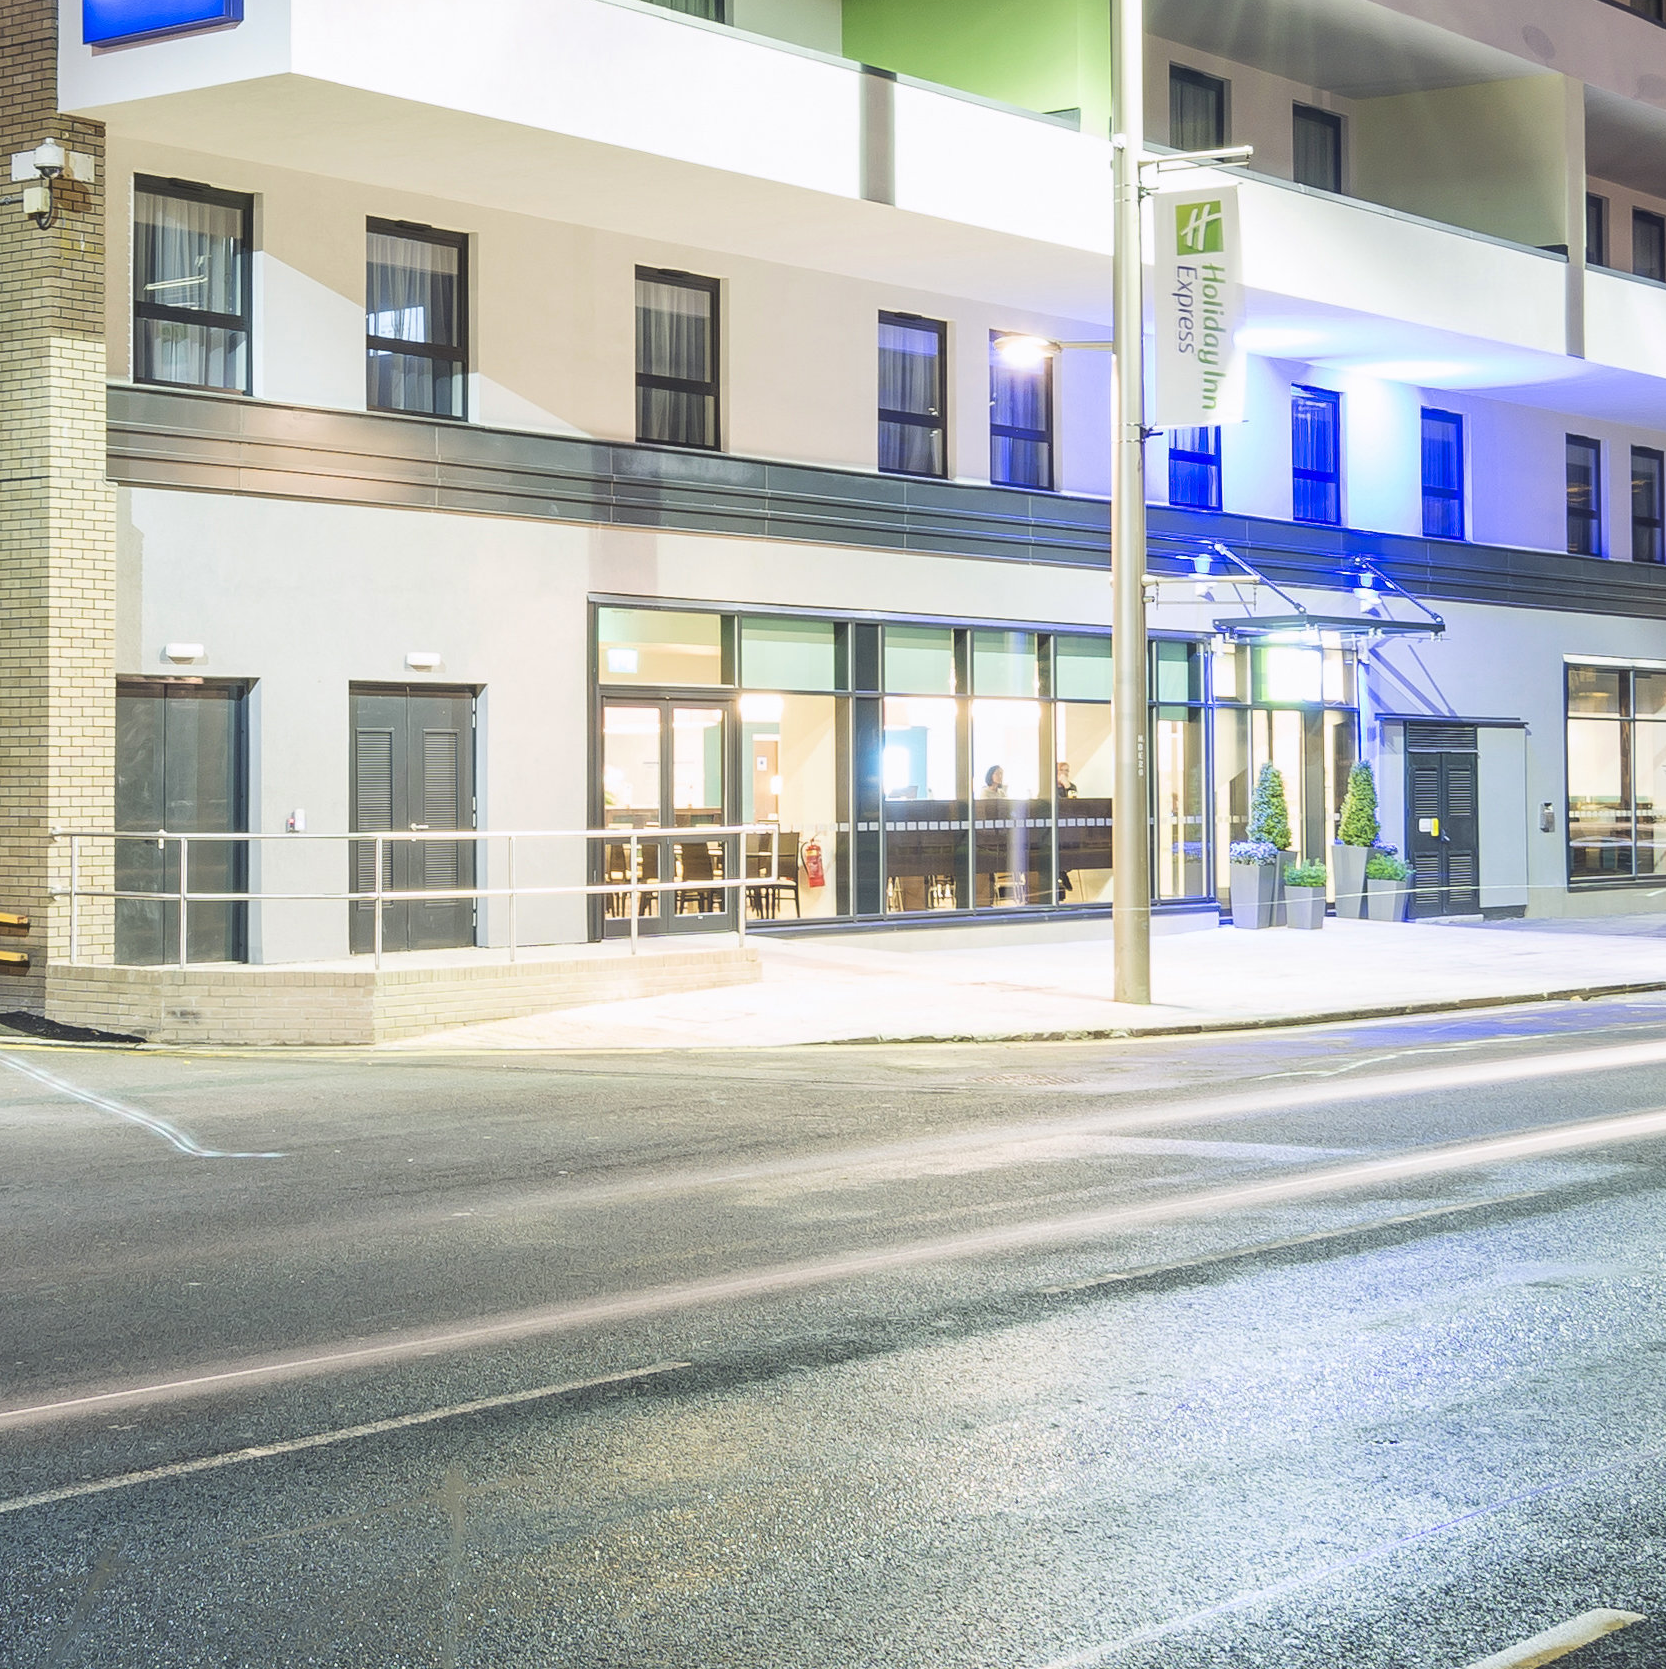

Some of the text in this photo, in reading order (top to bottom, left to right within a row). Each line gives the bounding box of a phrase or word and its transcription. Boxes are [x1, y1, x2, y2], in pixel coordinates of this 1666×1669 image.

[1171, 265, 1198, 354] Express
[1197, 262, 1227, 410] Holiday Inn
